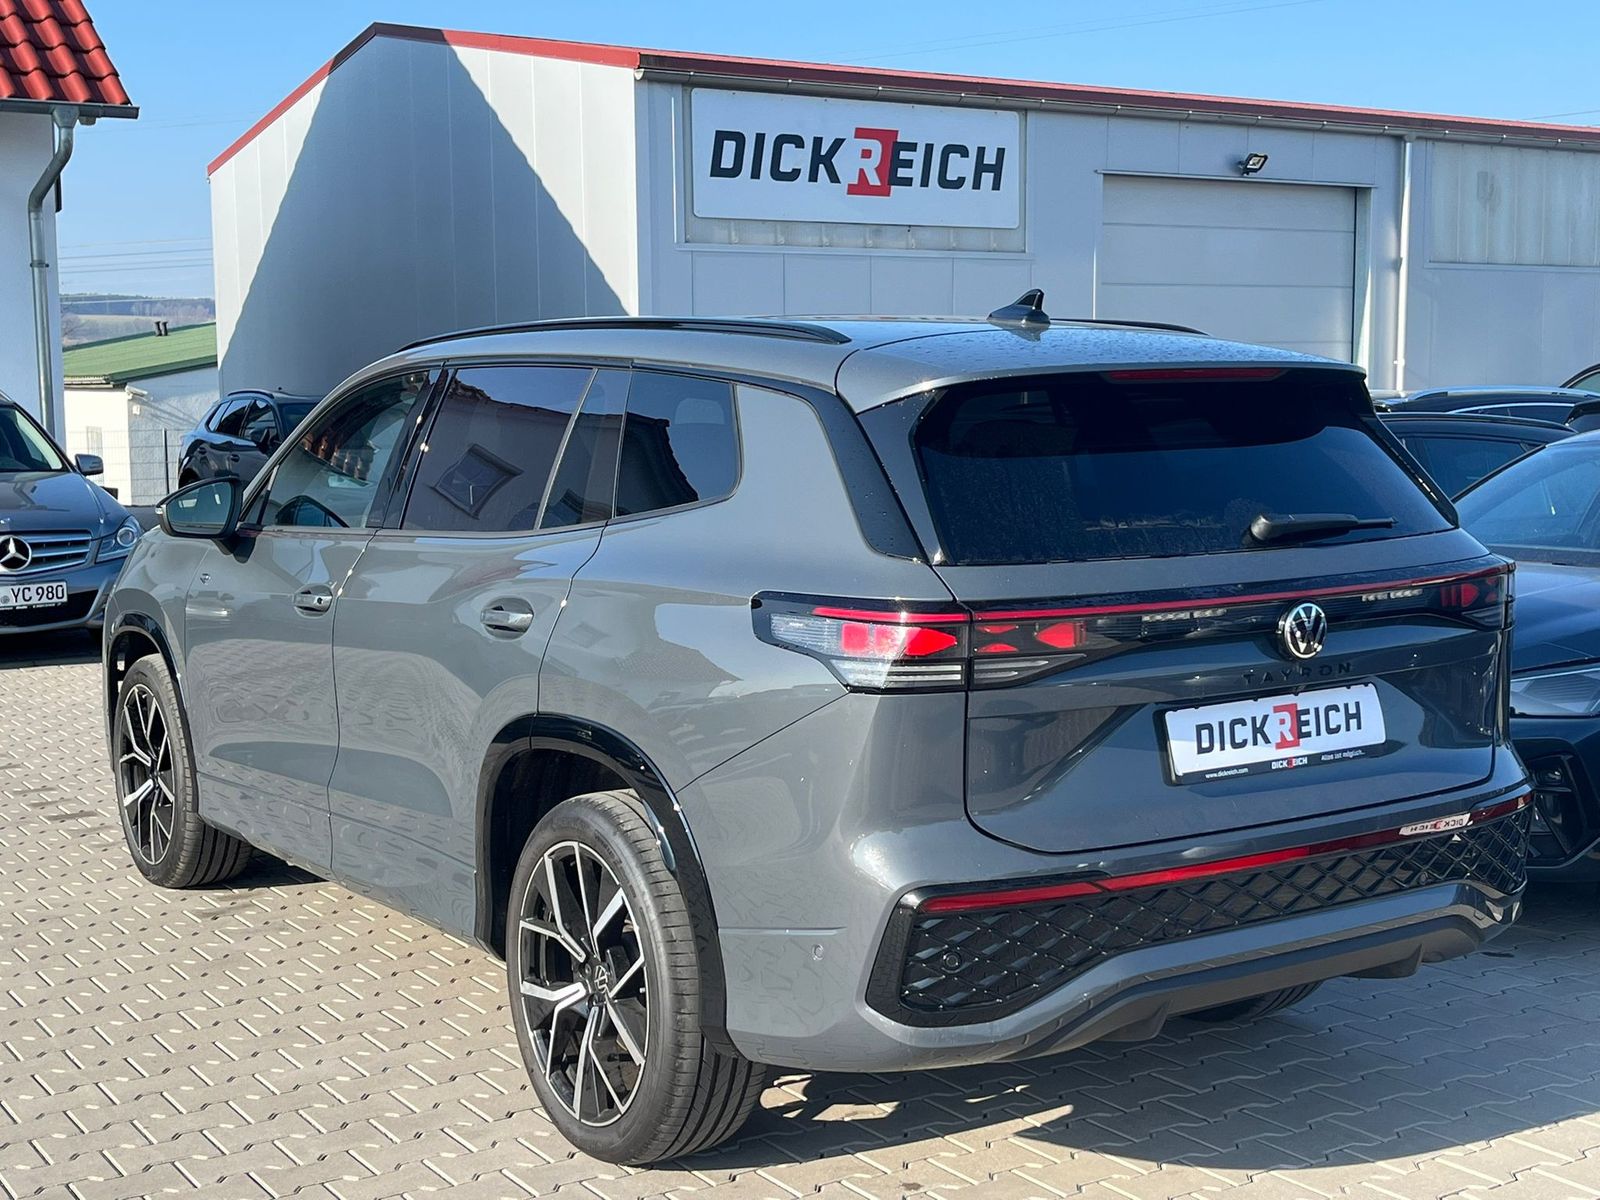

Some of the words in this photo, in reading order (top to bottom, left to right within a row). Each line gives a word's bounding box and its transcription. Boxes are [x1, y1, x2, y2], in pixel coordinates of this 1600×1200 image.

[709, 127, 1006, 197] DICKREICH
[10, 587, 32, 603] YC
[36, 584, 65, 601] 980
[1242, 662, 1352, 686] TAYRON
[1194, 701, 1362, 755] DICKREICH
